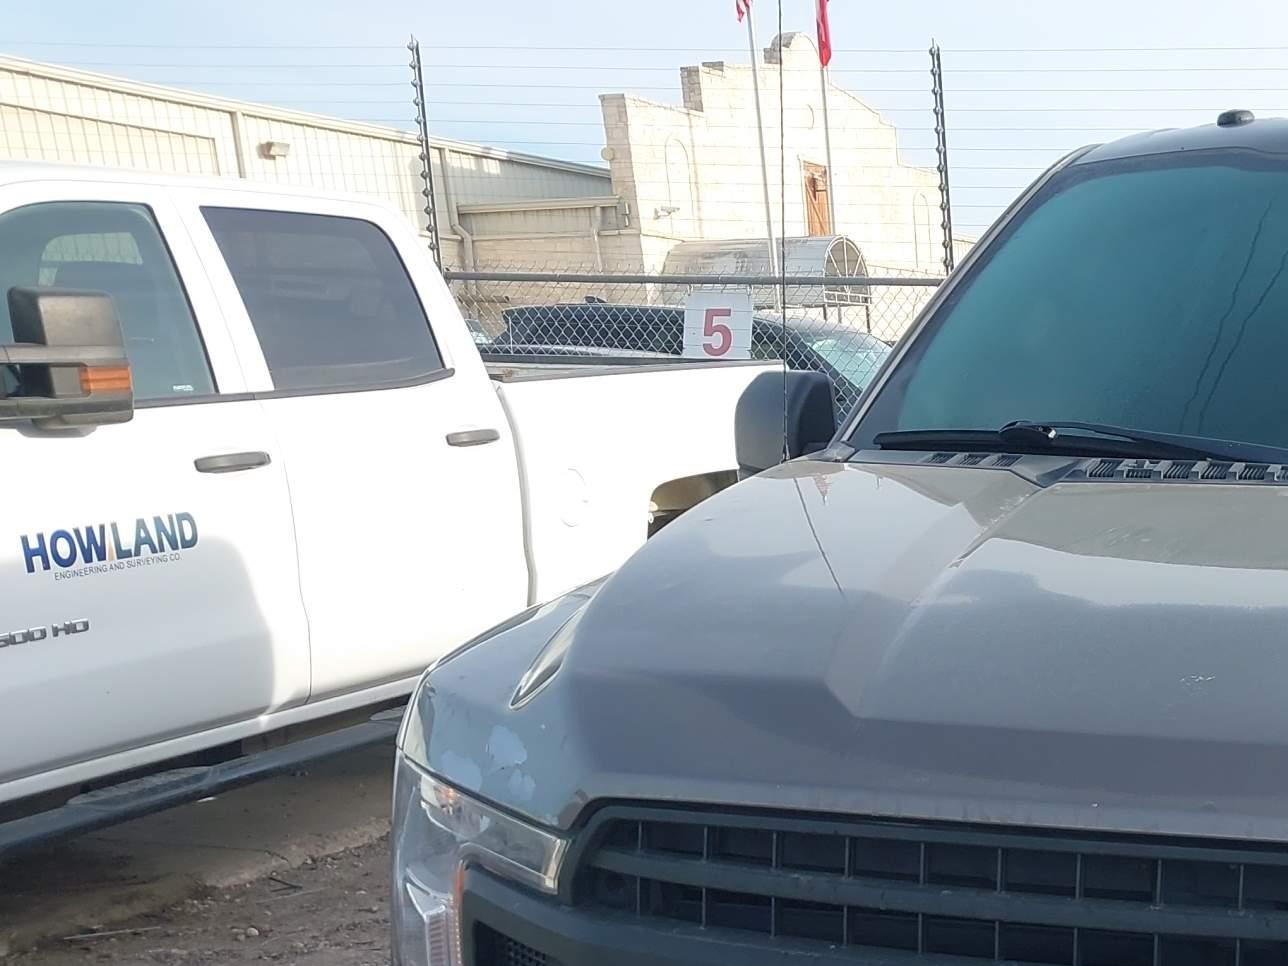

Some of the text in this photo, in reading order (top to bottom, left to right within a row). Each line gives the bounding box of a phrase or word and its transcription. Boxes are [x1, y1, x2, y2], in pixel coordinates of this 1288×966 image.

[703, 308, 732, 357] 5
[20, 511, 199, 574] HOWLAND
[54, 564, 108, 581] ENGINEERING
[109, 560, 125, 572] AND
[126, 554, 168, 569] SURVEYING
[52, 618, 90, 638] HD
